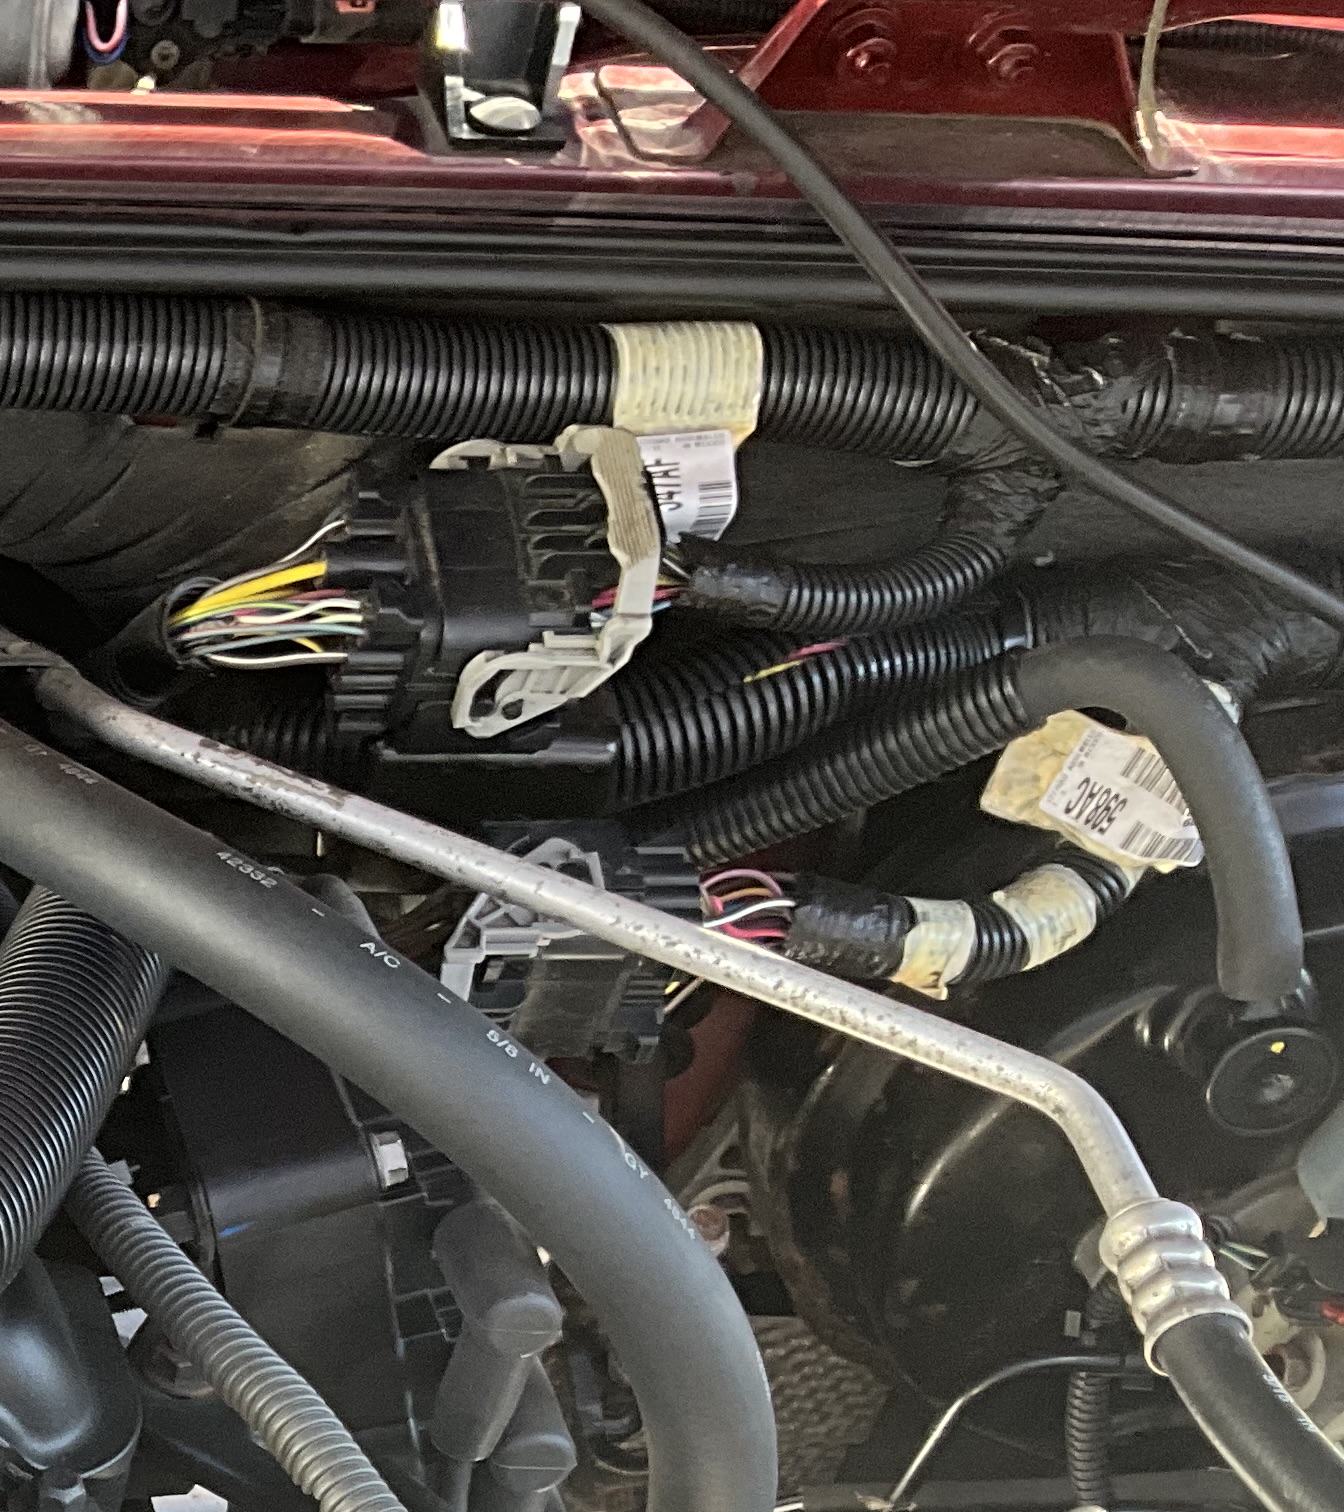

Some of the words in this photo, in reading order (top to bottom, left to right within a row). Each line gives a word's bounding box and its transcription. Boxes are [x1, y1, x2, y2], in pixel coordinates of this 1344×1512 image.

[1064, 777, 1128, 836] 598AC
[215, 851, 279, 890] 42332
[359, 940, 402, 970] A/C
[485, 1029, 519, 1059] 5/8
[527, 1062, 551, 1085] IN
